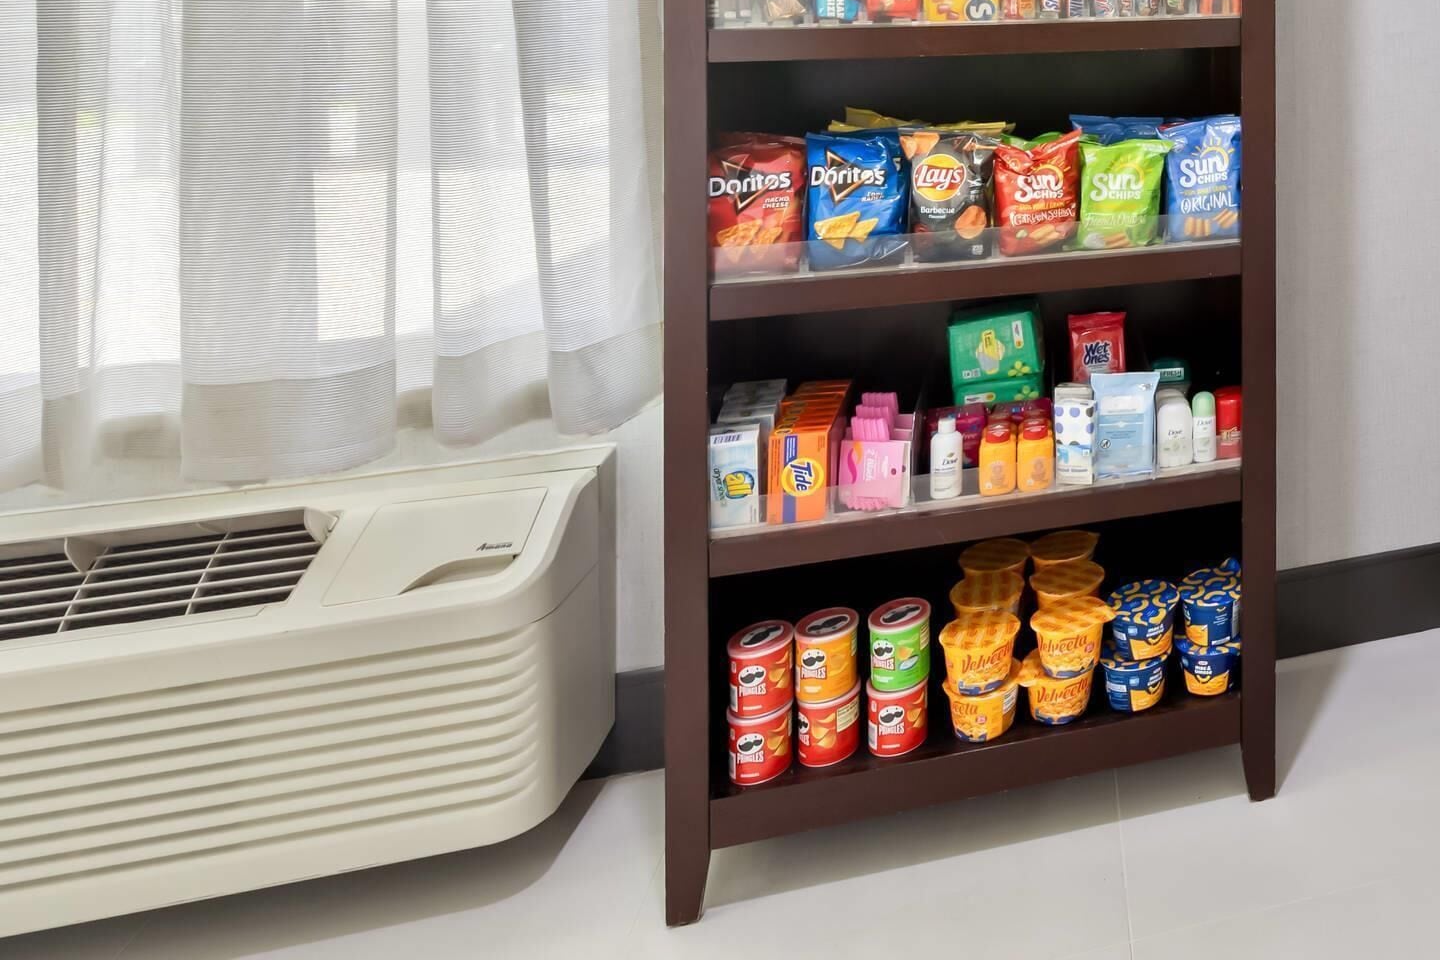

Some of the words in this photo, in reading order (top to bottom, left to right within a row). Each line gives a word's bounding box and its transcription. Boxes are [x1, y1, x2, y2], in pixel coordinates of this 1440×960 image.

[811, 166, 885, 186] Doritos
[1180, 154, 1229, 188] Sun
[1197, 172, 1228, 185] CHIPS
[709, 172, 791, 197] Doritos
[1015, 172, 1057, 203] Sun
[1090, 172, 1143, 202] Sun
[1108, 189, 1141, 200] CHIPS
[920, 205, 955, 214] Barbecue
[1180, 191, 1238, 214] ORIGINAL
[1083, 351, 1110, 366] Ones
[1085, 341, 1110, 354] Wet
[724, 472, 754, 498] all
[789, 462, 813, 492] Tide
